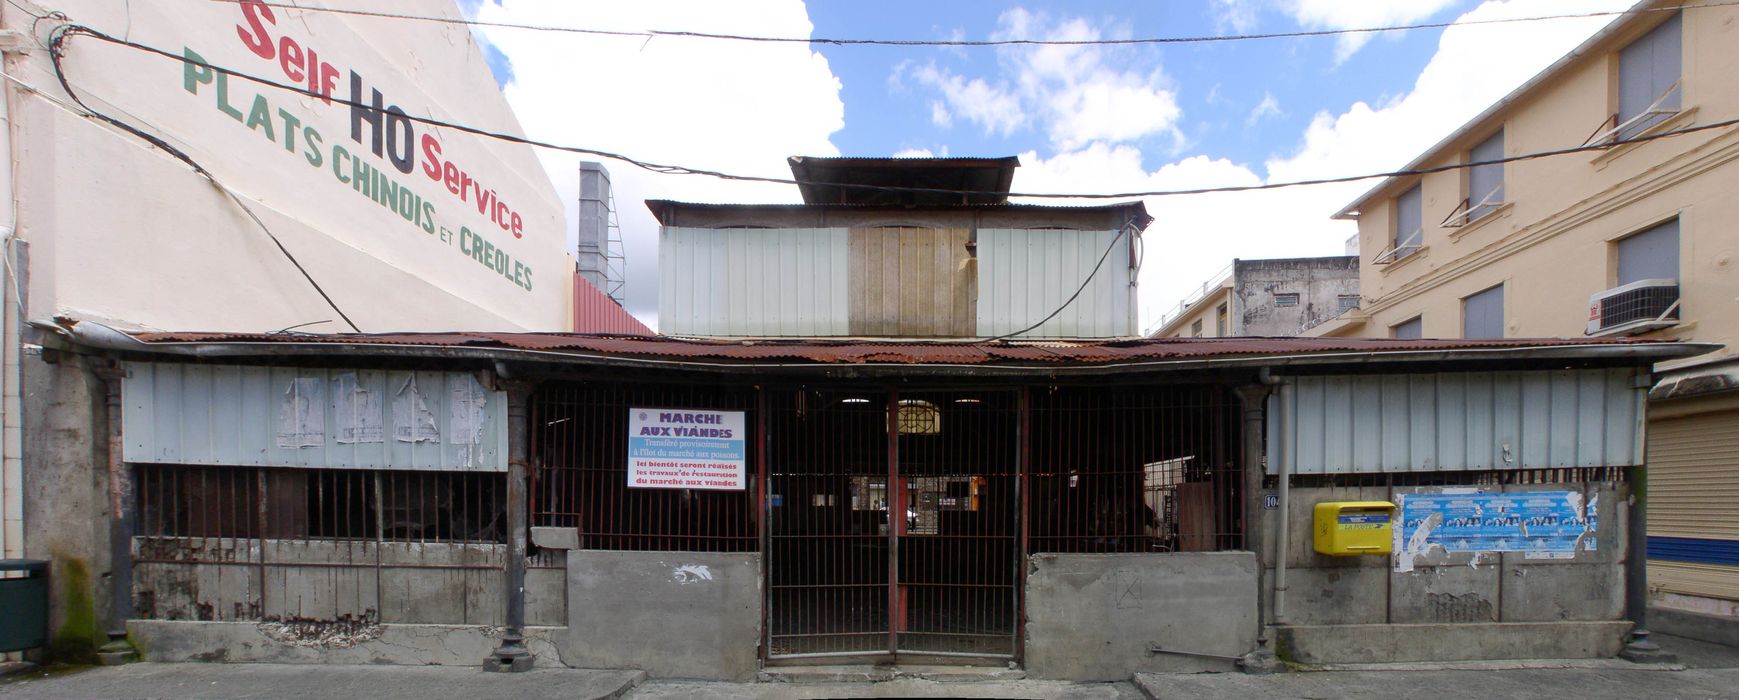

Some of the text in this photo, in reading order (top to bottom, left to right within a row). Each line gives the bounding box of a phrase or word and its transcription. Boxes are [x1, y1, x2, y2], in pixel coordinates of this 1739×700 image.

[237, 0, 523, 239] Self HO Service
[184, 46, 533, 292] PLATS CHINOIS ET CREOLES
[660, 412, 723, 424] MARCHE
[640, 426, 733, 438] AUX VIANDES
[650, 477, 683, 485] marché
[705, 479, 737, 487] viandes
